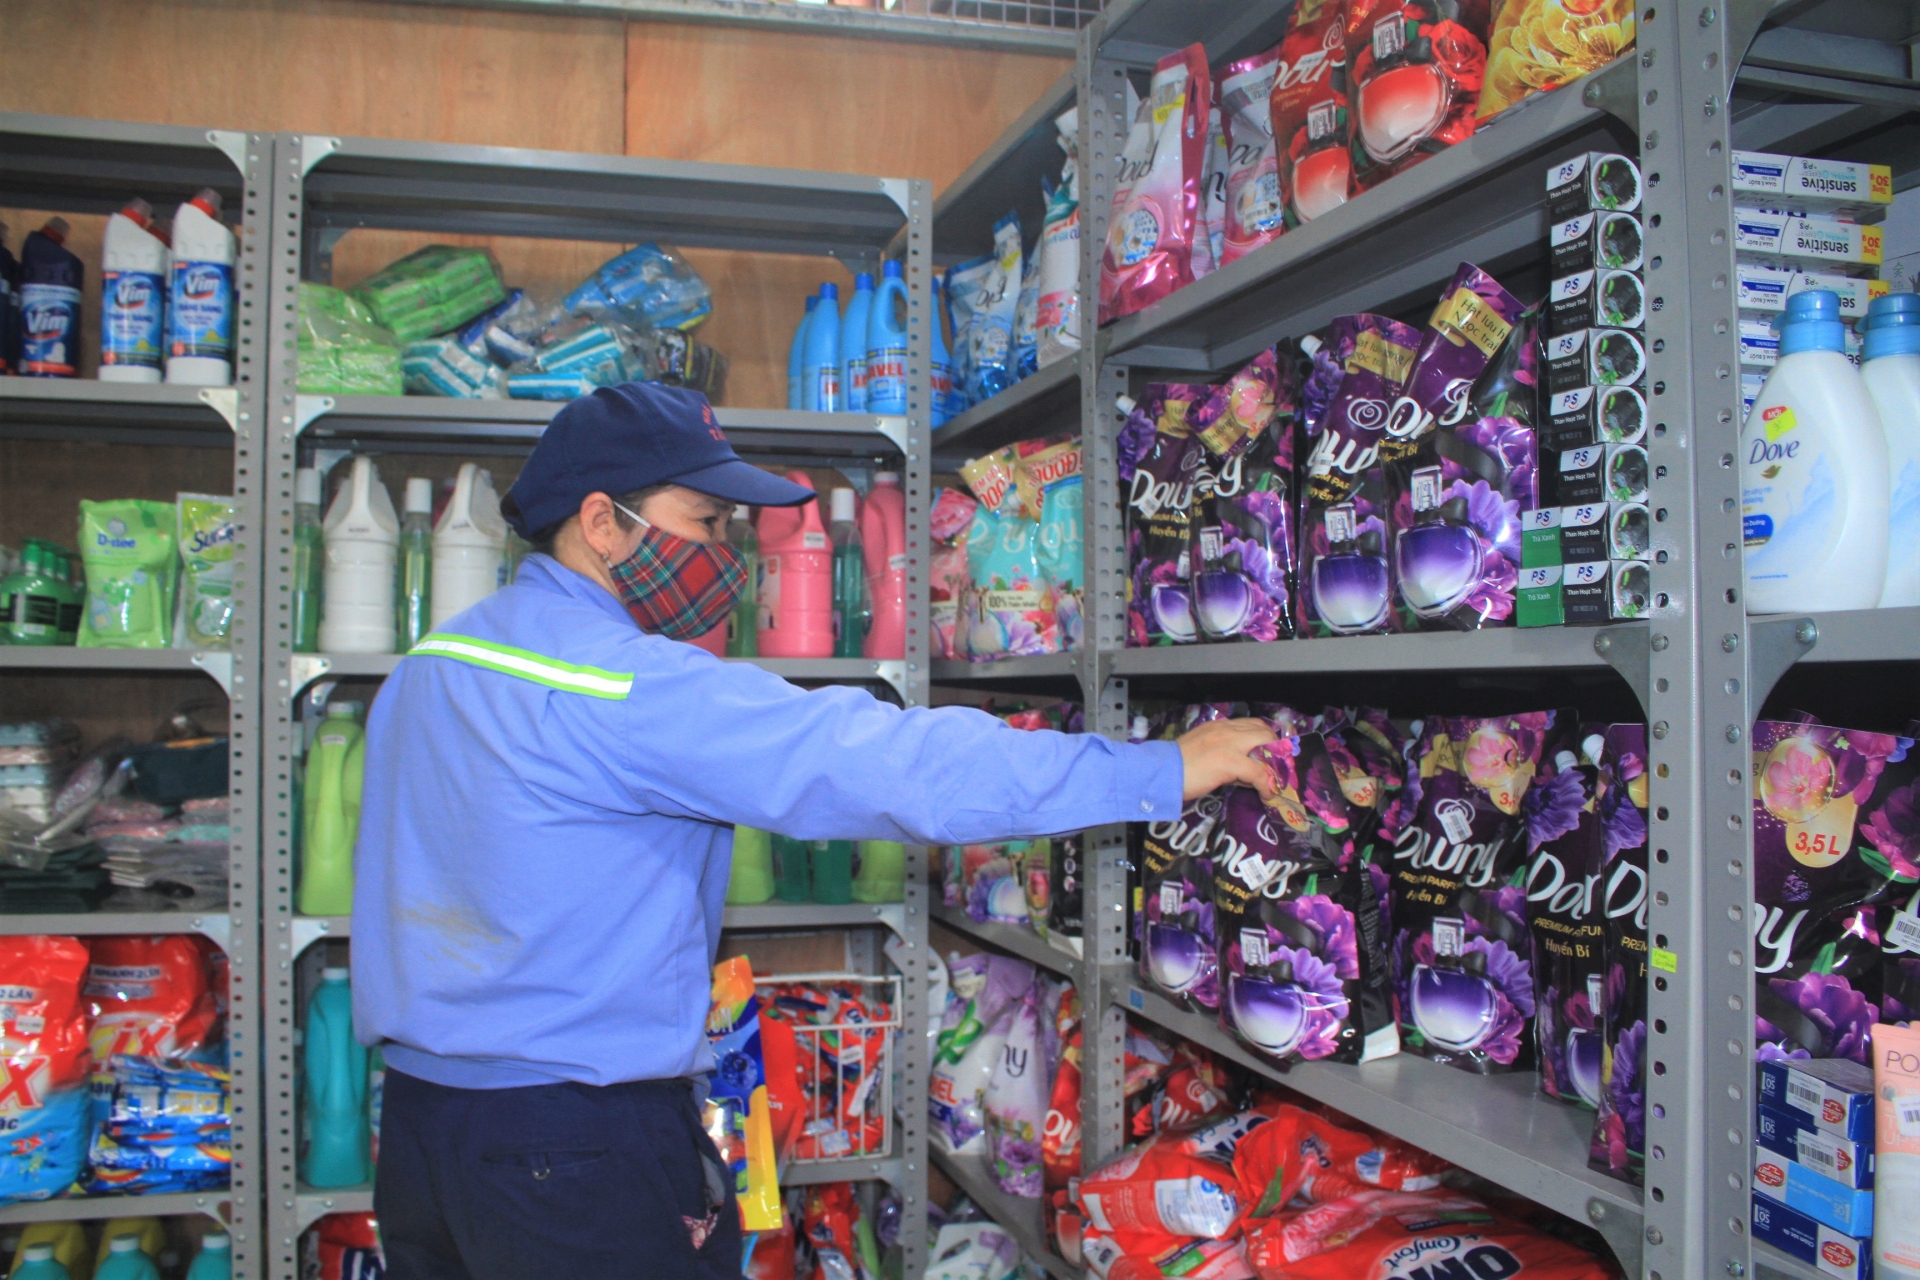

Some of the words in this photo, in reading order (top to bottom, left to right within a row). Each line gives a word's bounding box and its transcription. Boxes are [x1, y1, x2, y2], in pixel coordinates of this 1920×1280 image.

[1801, 177, 1857, 193] sensitive
[1797, 237, 1849, 254] sensitive
[117, 283, 152, 304] Vim
[185, 272, 221, 295] Vim
[26, 309, 69, 334] Vim
[1480, 333, 1499, 351] trai
[1749, 438, 1800, 465] Dove
[1795, 831, 1826, 856] 3,5
[1827, 835, 1841, 856] L
[1383, 1235, 1461, 1272] Comfort
[1823, 1246, 1852, 1265] Lifebuoy
